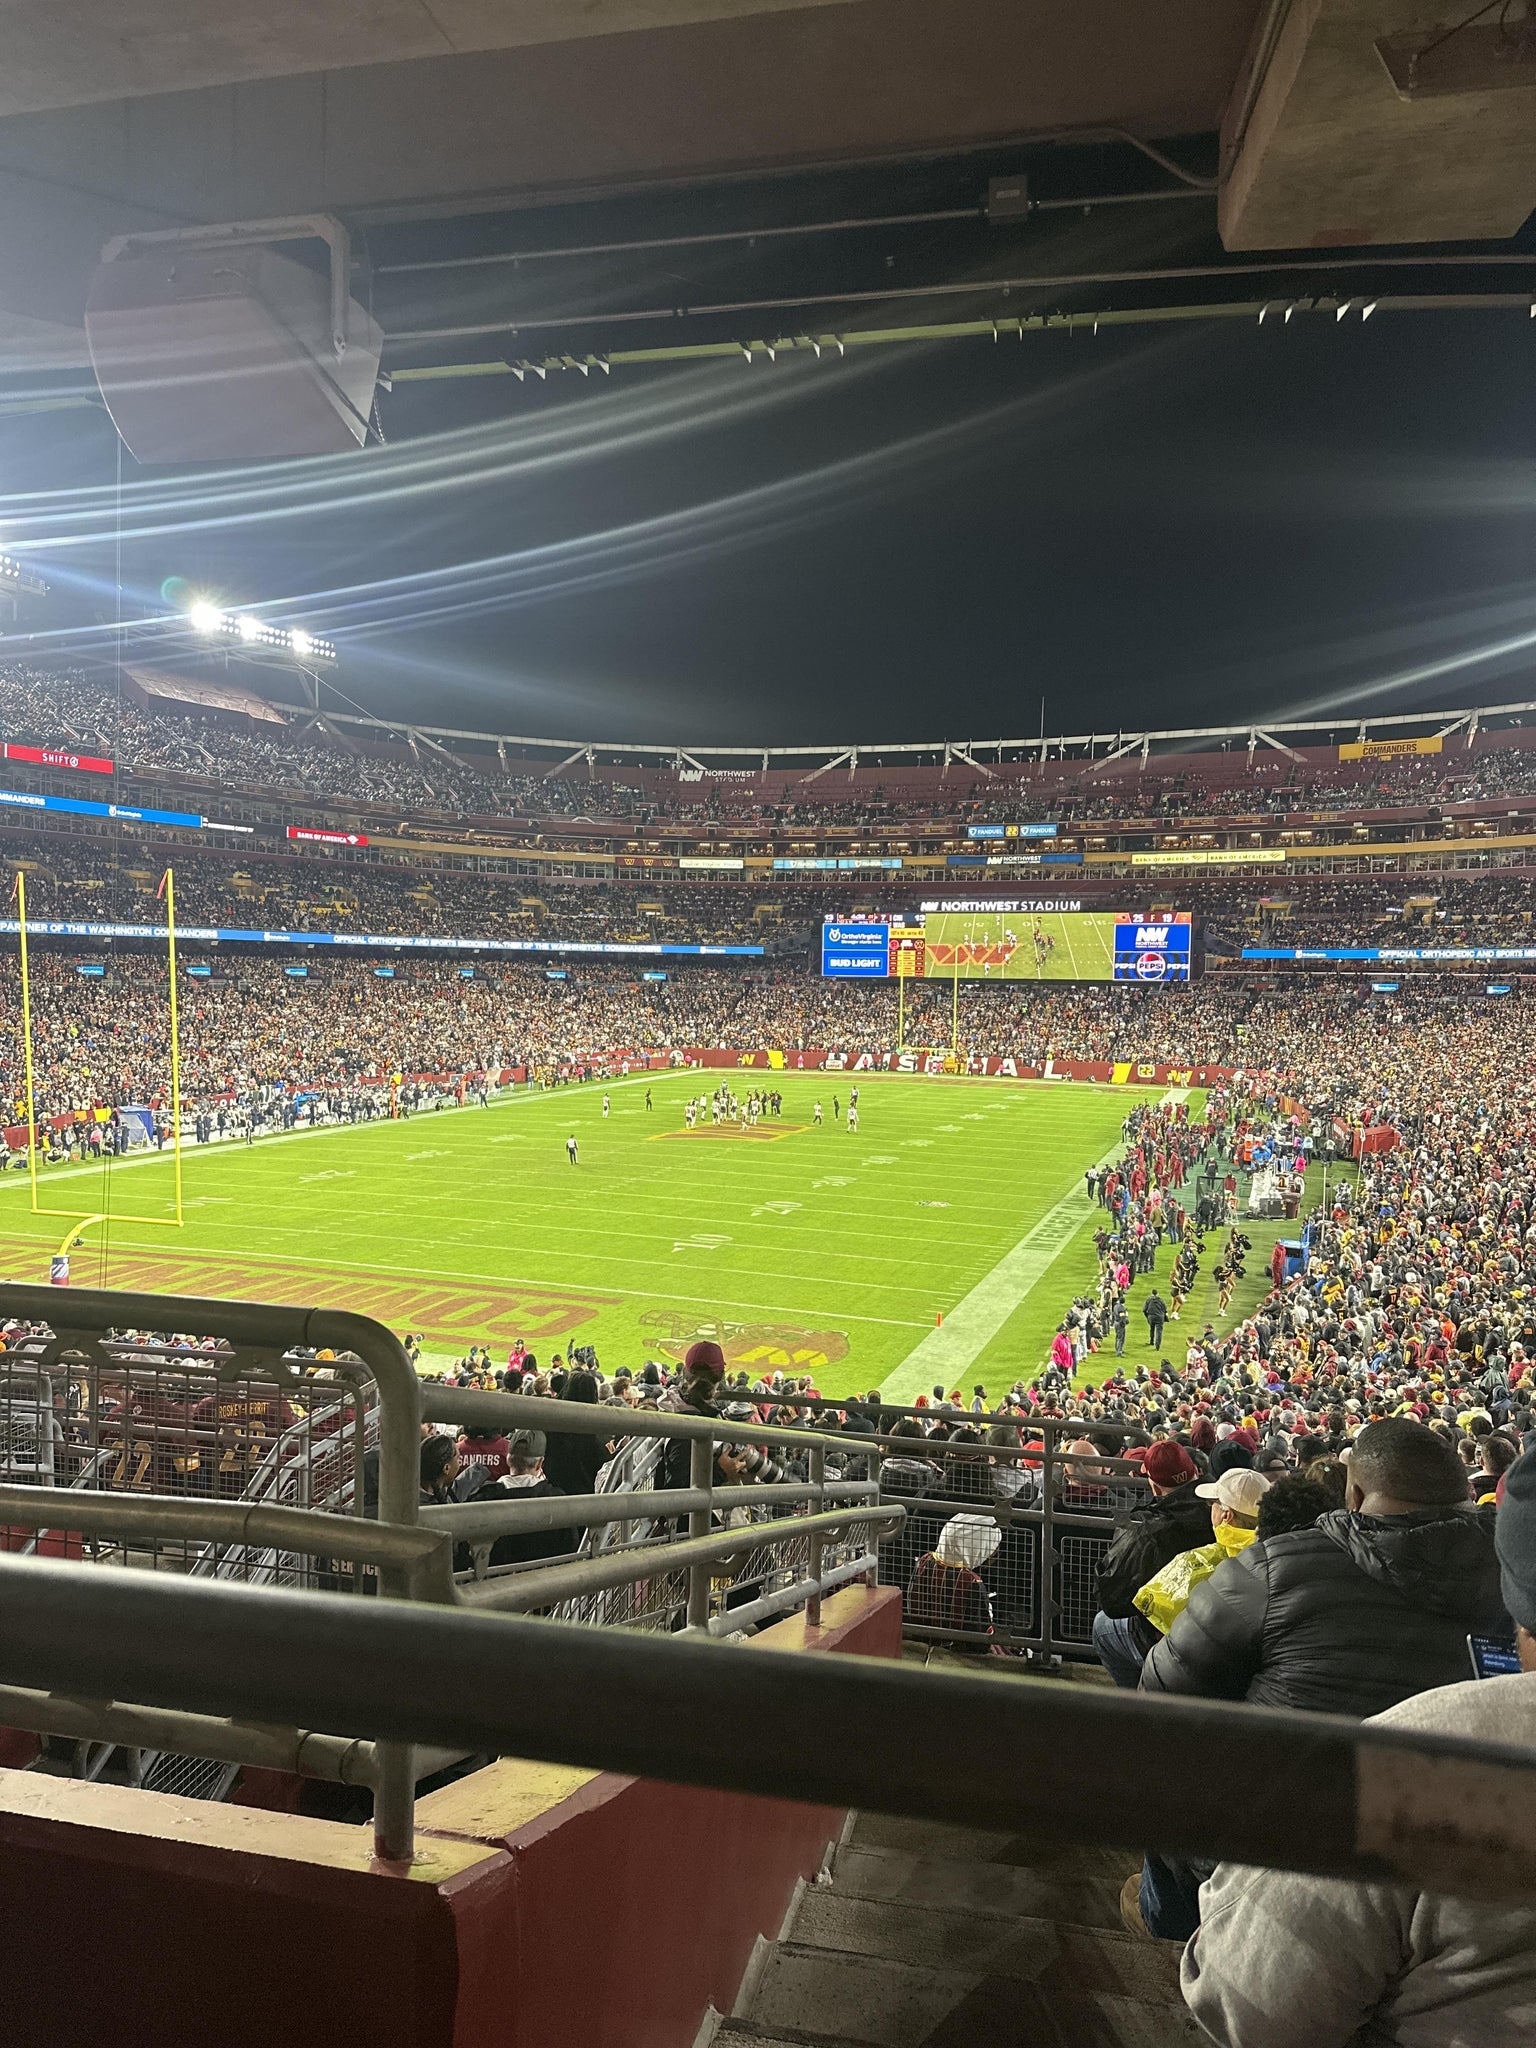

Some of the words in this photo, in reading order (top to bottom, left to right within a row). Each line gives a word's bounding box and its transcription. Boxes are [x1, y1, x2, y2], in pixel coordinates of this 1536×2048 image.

[1362, 743, 1417, 756] COMMANDERS
[679, 770, 704, 782] NW
[704, 770, 756, 778] NORTHWEST
[297, 831, 313, 840] BANK
[322, 834, 347, 843] AMERICA
[1006, 827, 1018, 836] 22
[941, 901, 1021, 911] NORTHWEST
[1021, 900, 1081, 911] STADIUM
[1133, 913, 1144, 923] 25
[1162, 913, 1173, 923] 19
[50, 923, 64, 932] OF
[66, 924, 86, 933] THE
[88, 925, 152, 936] WASHINGTON
[1135, 927, 1169, 942] NW
[333, 935, 366, 944] OFFICIAL
[368, 936, 413, 946] ORTHOPEDIC
[414, 938, 429, 946] AND
[430, 938, 456, 948] SPORTS
[535, 942, 549, 950] THE
[1378, 949, 1419, 958] OFFICIAL
[1421, 949, 1475, 958] ORTHOPEDIC
[1477, 949, 1494, 958] AND
[1496, 949, 1522, 958] SPORTS
[830, 959, 851, 967] BUD
[851, 959, 880, 967] LIGHT
[1139, 1066, 1153, 1076] 22
[672, 1233, 734, 1253] 10
[111, 1440, 151, 1491] 22
[458, 1454, 501, 1467] SANDERS
[331, 1558, 380, 1577] SERIC
